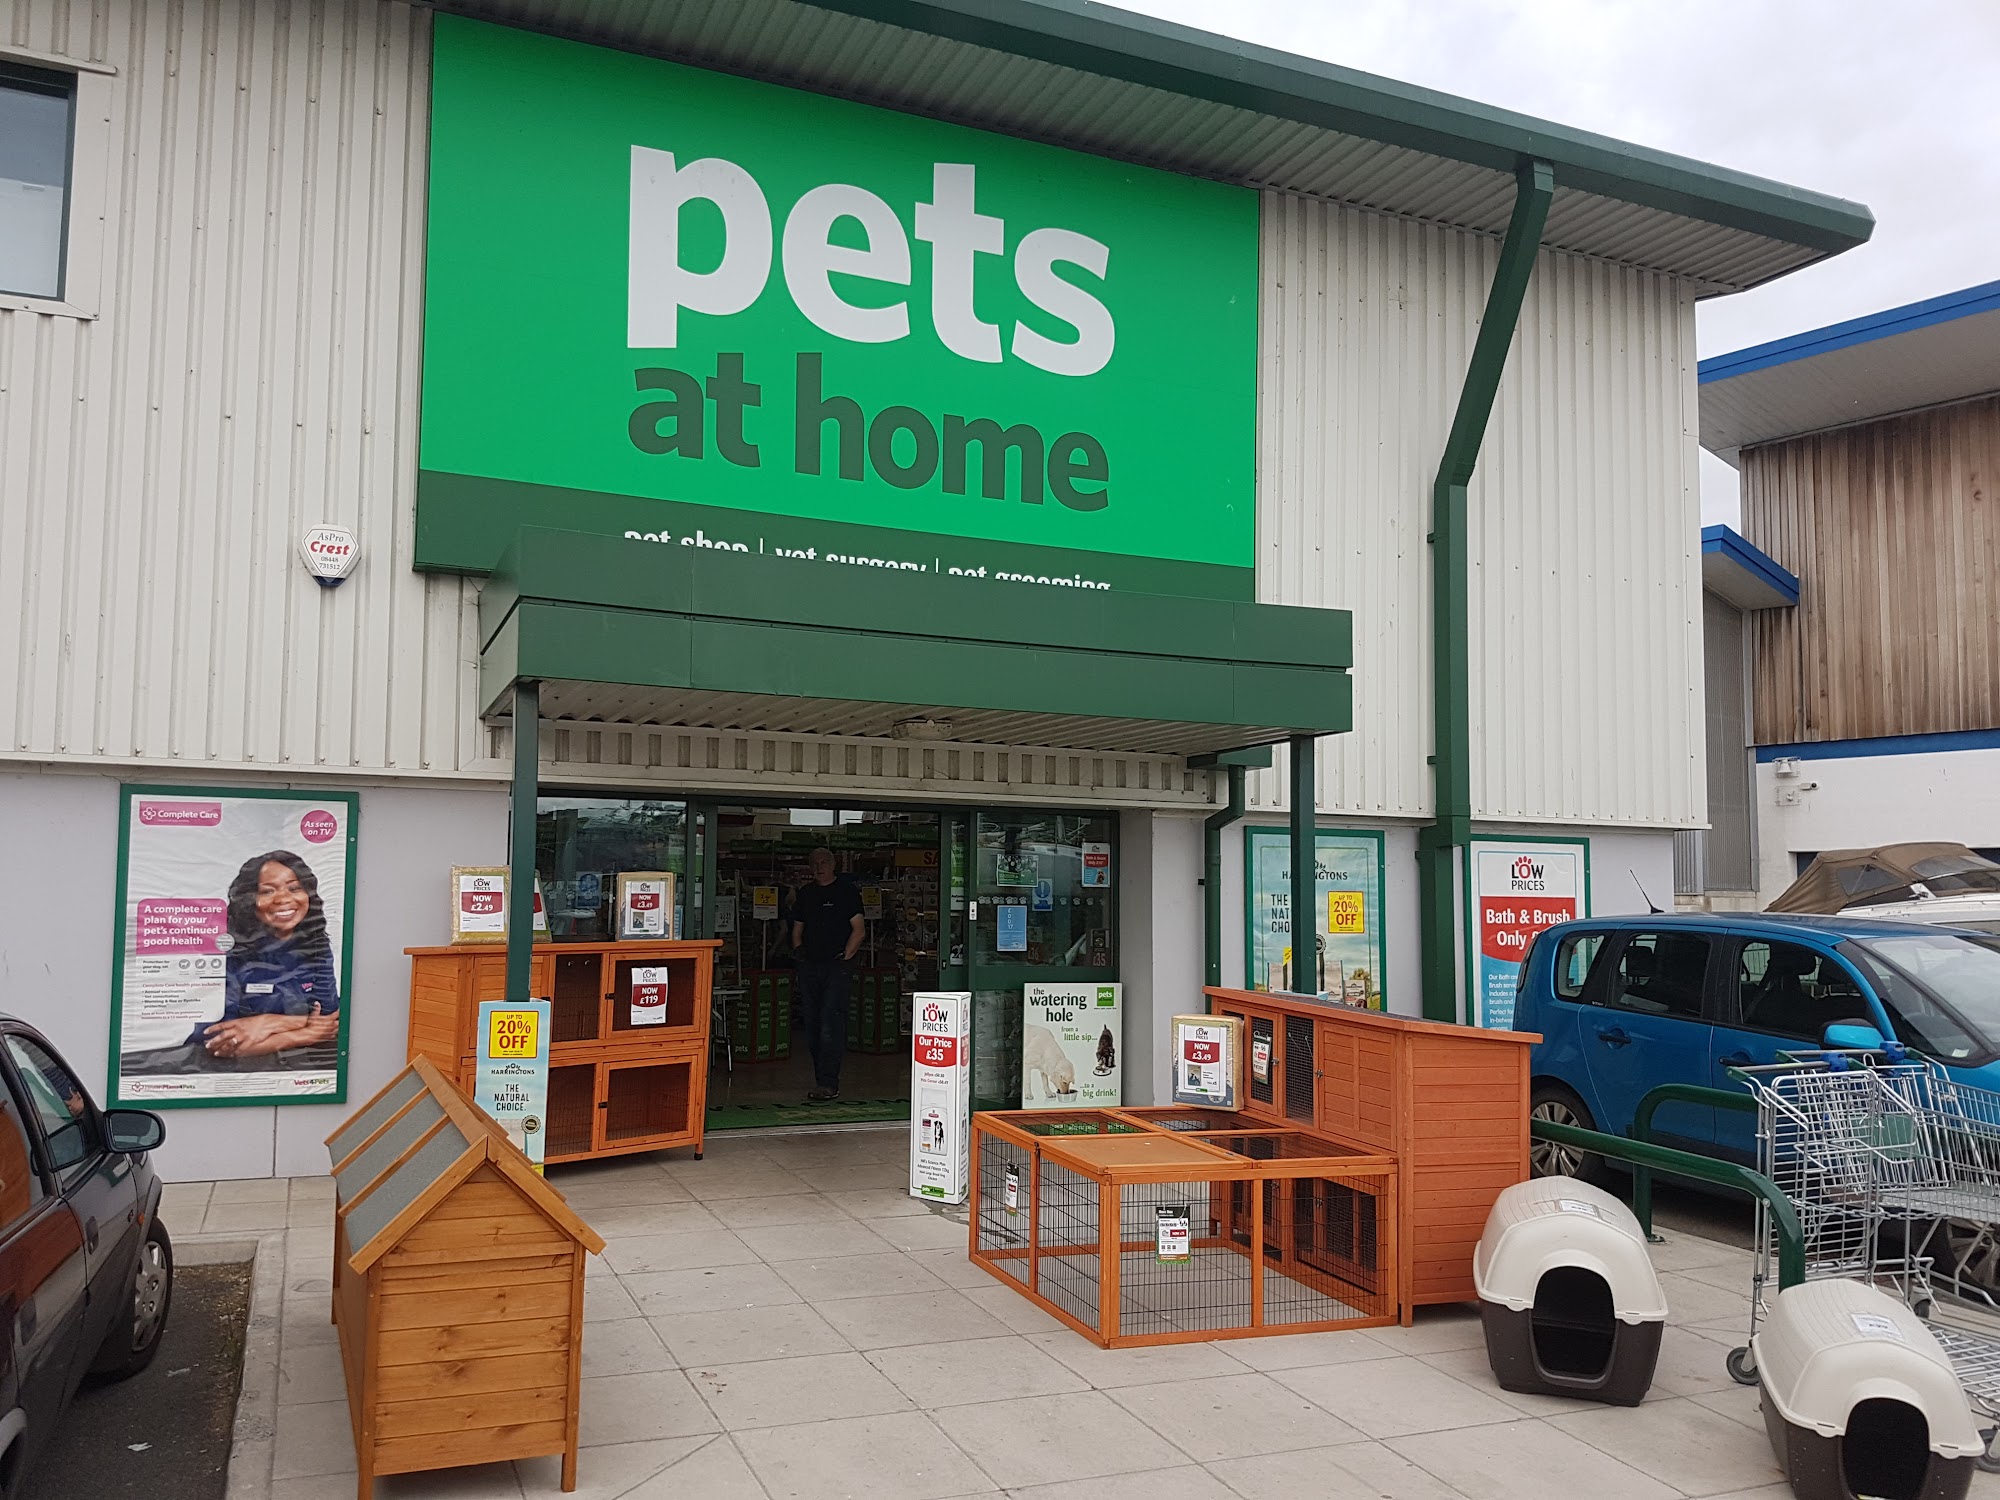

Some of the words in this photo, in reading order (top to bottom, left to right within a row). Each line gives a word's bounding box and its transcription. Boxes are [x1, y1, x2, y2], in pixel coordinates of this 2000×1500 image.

[627, 145, 1116, 376] pets
[627, 352, 762, 469] at
[794, 352, 1110, 512] home
[318, 532, 344, 543] AsPro
[310, 540, 350, 556] Crest
[158, 810, 198, 822] Complete
[199, 811, 218, 819] Care
[304, 820, 315, 828] As
[319, 828, 331, 836] TV
[1511, 863, 1545, 879] LOW
[1511, 880, 1545, 891] PRICES
[1271, 894, 1288, 906] THE
[144, 905, 152, 913] A
[154, 905, 199, 915] complete
[471, 903, 493, 911] £2.49
[1333, 900, 1359, 913] 20%
[144, 915, 166, 925] plan
[168, 915, 181, 923] for
[183, 917, 207, 926] your
[1335, 913, 1358, 925] OFF
[1486, 908, 1516, 924] Bath
[1519, 909, 1530, 924] &
[1533, 908, 1570, 925] Brush
[169, 926, 219, 935] continued
[1271, 921, 1290, 933] CHO
[144, 937, 170, 948] good
[171, 936, 203, 946] health
[1496, 930, 1527, 950] Only
[642, 970, 657, 979] LOW
[640, 995, 659, 1005] £119
[1098, 991, 1113, 999] pets
[1029, 993, 1087, 1010] watering
[922, 1009, 948, 1022] LOW
[1046, 1008, 1073, 1022] hole
[496, 1020, 531, 1034] 20%
[922, 1021, 948, 1032] PRICES
[498, 1035, 529, 1049] OFF
[918, 1036, 931, 1046] Our
[933, 1037, 953, 1048] Price
[1064, 1033, 1080, 1041] little
[1194, 1043, 1210, 1051] NOW
[925, 1048, 944, 1060] £35
[1192, 1051, 1212, 1061] £3.49
[505, 1084, 520, 1093] THE
[1082, 1090, 1094, 1099] big
[1095, 1089, 1117, 1097] drink!
[494, 1093, 530, 1102] NATURAL
[496, 1102, 527, 1112] CHOICE.
